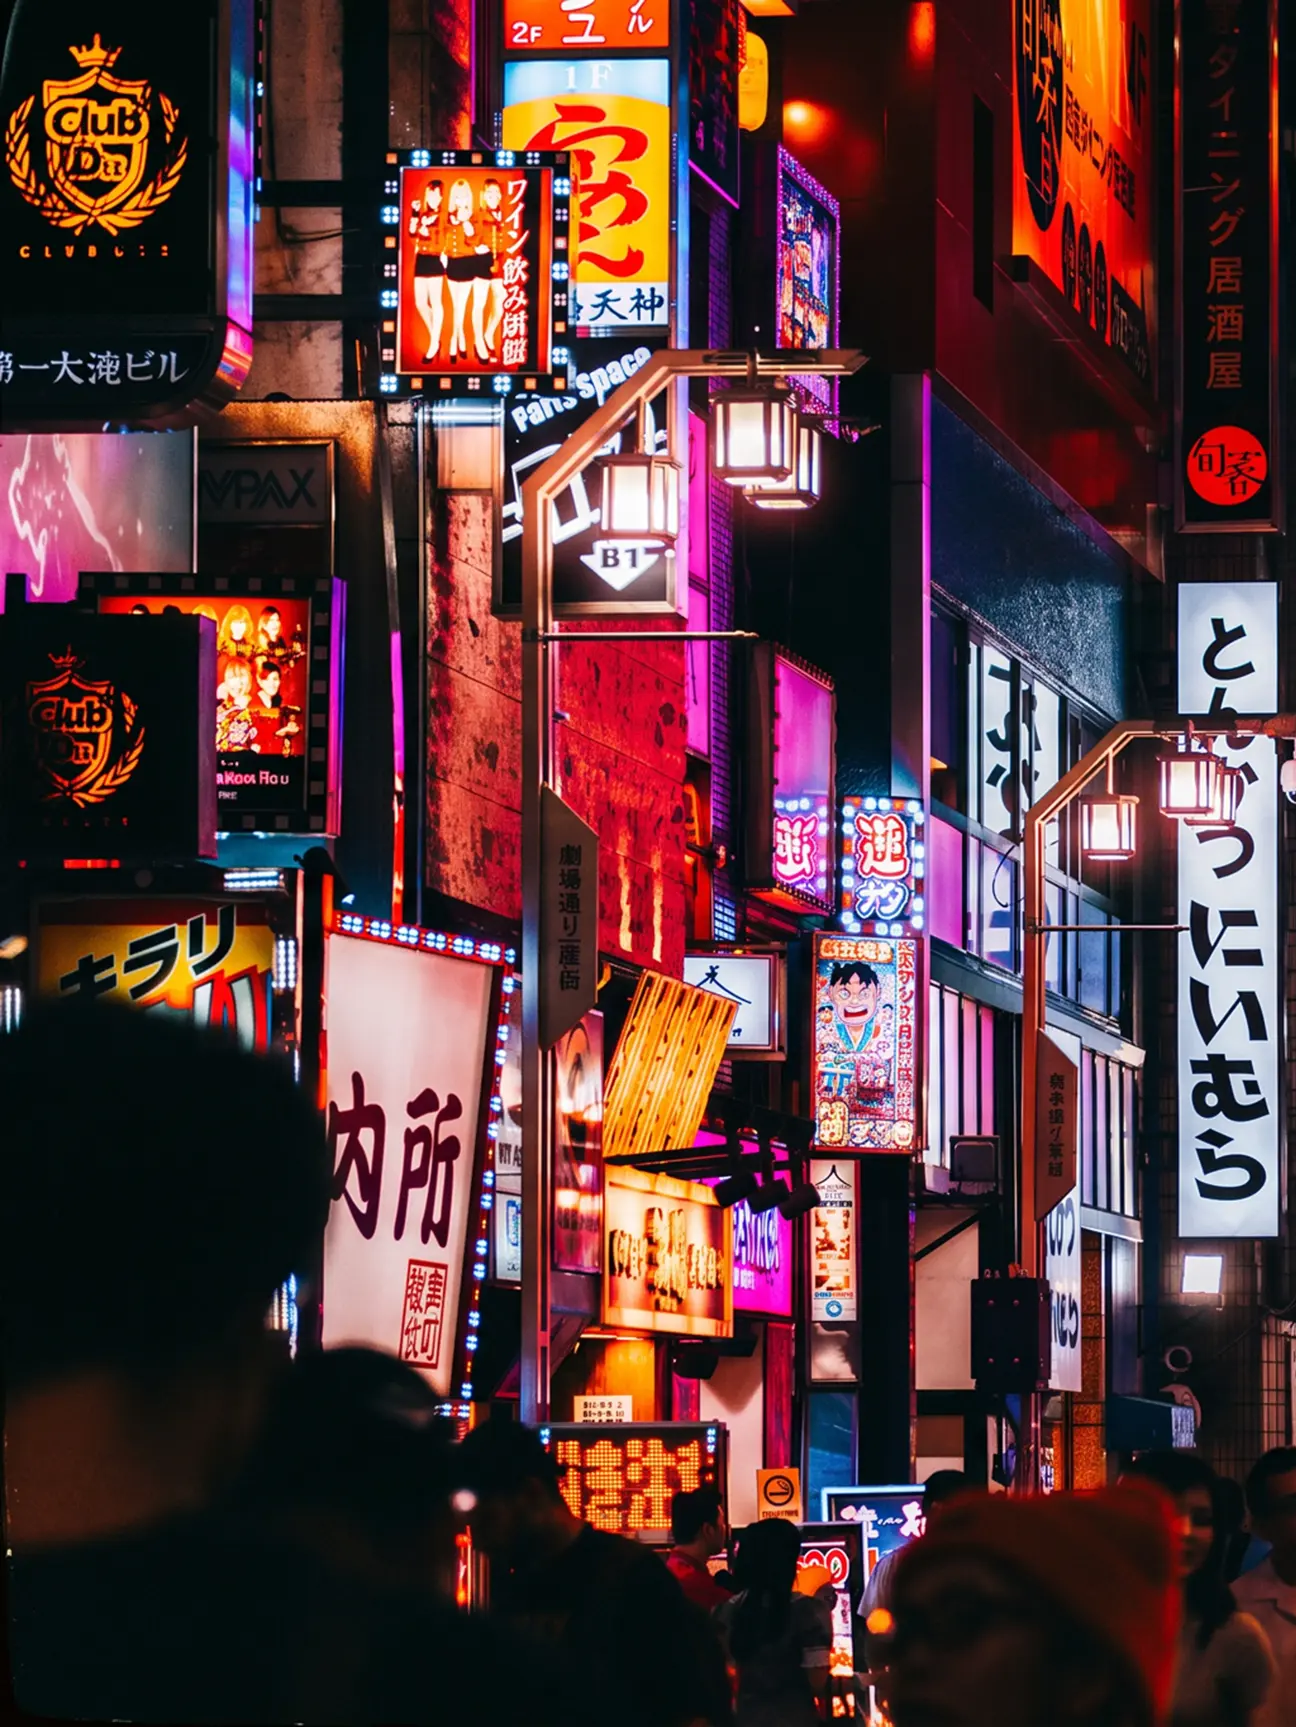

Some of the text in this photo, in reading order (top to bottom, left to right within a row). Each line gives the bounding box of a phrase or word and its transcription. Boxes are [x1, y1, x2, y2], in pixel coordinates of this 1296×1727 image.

[511, 22, 543, 43] 2F
[563, 65, 613, 90] 1F
[601, 548, 638, 569] B1
